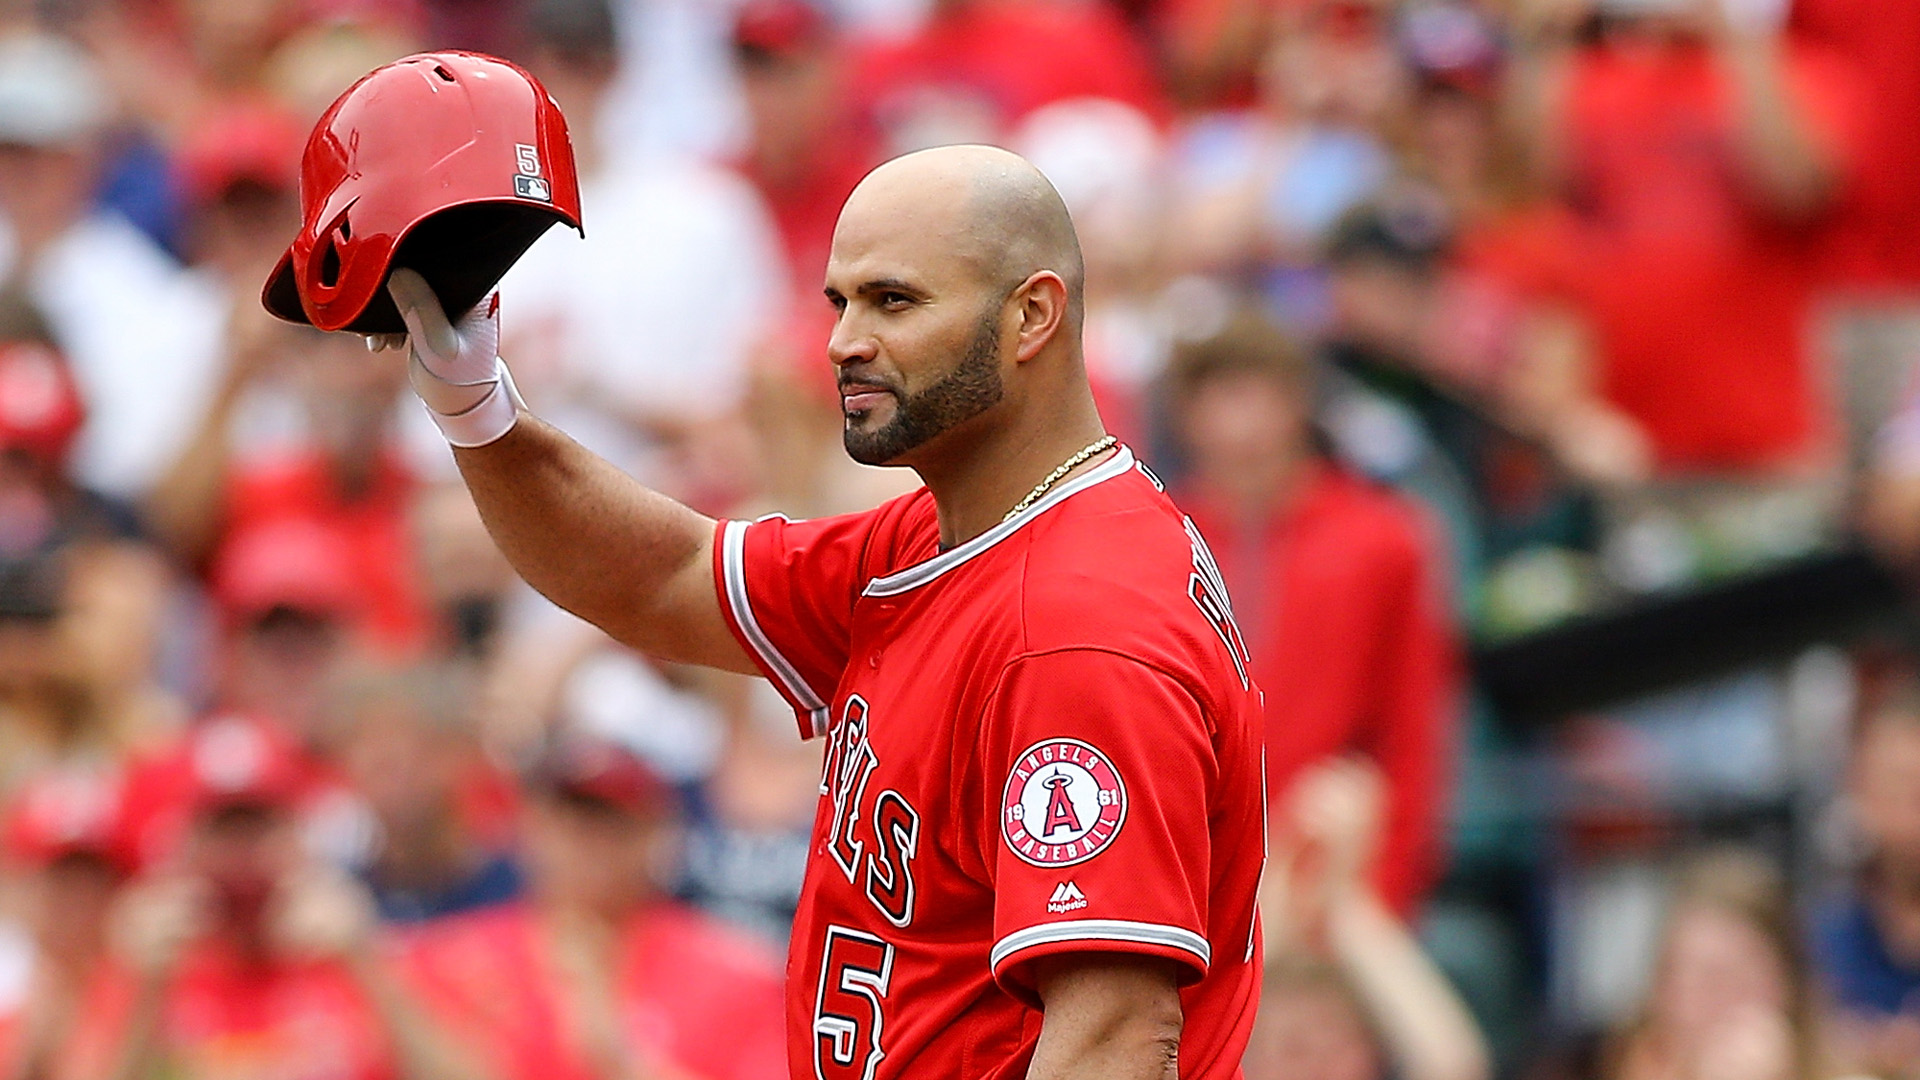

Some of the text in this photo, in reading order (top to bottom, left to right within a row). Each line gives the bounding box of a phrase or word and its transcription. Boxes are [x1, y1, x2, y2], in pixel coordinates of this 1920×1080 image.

[514, 143, 541, 177] 5
[1015, 744, 1099, 782] ANGELS
[1006, 789, 1119, 823] 19 61
[1011, 818, 1116, 861] BASEBALL
[1047, 899, 1088, 914] Majestic
[811, 924, 895, 1080] 5
